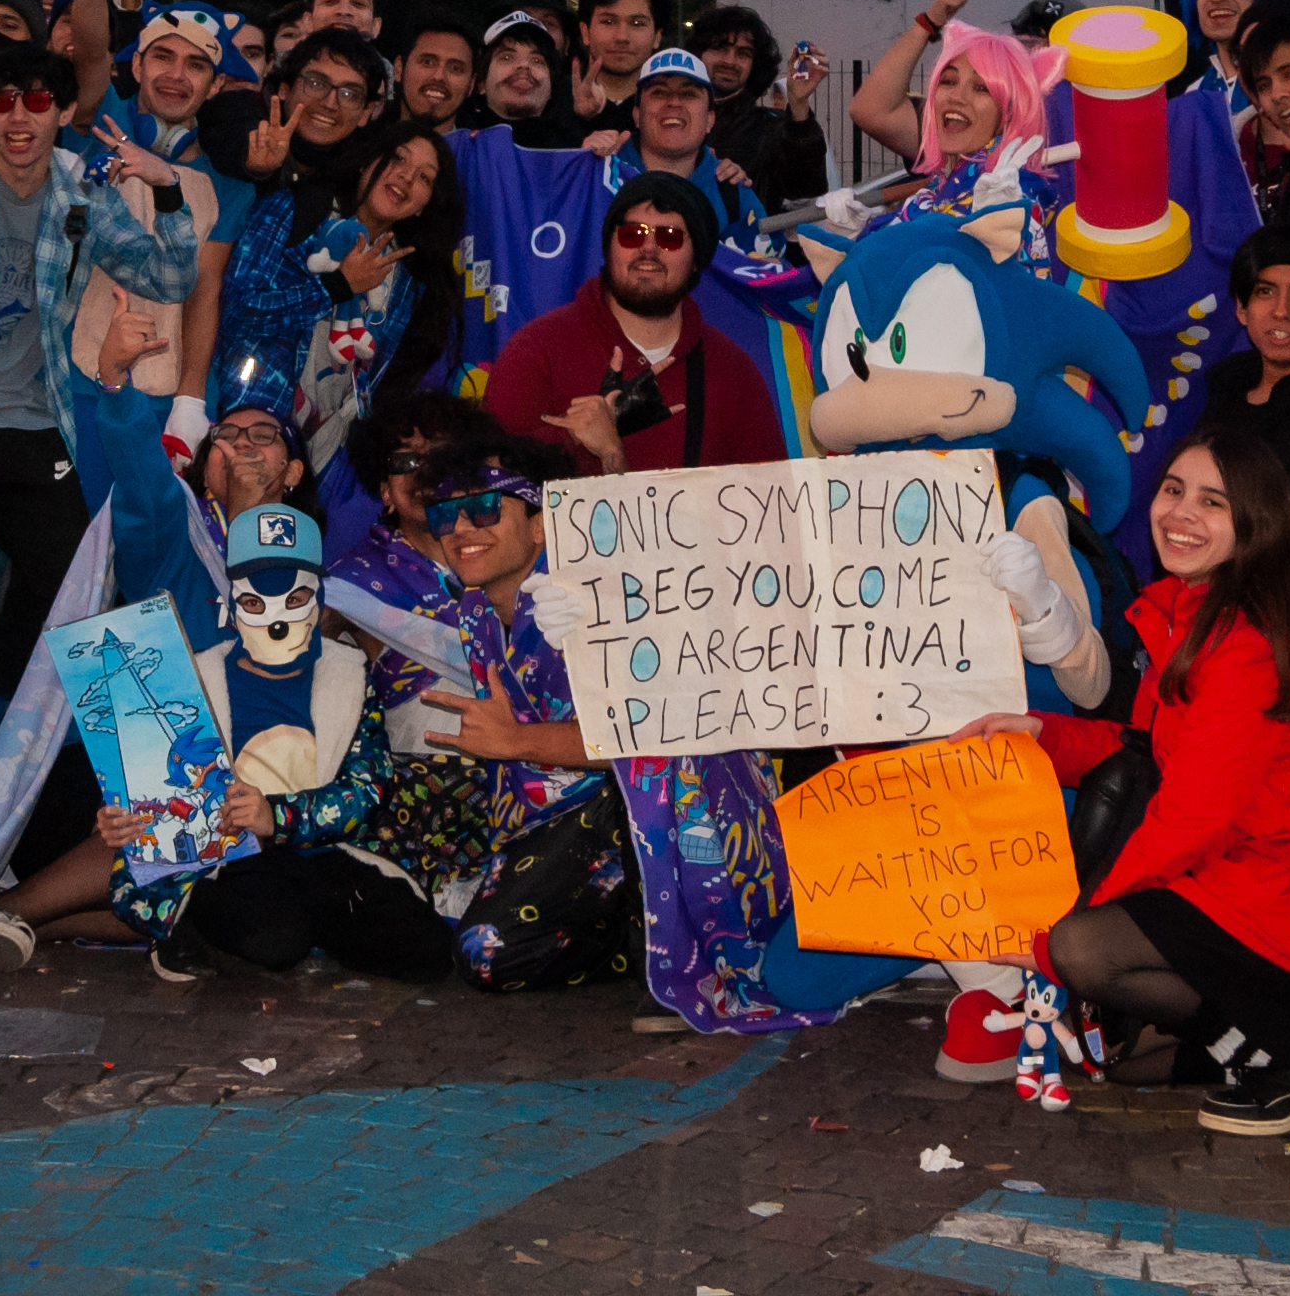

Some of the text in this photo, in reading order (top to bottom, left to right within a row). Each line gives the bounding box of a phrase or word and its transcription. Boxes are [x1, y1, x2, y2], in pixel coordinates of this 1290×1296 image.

[650, 53, 695, 72] SEGA
[582, 578, 611, 628] I
[622, 567, 715, 623] BEG
[586, 636, 661, 688] TO
[990, 830, 1057, 871] FOR
[910, 888, 987, 927] YOU
